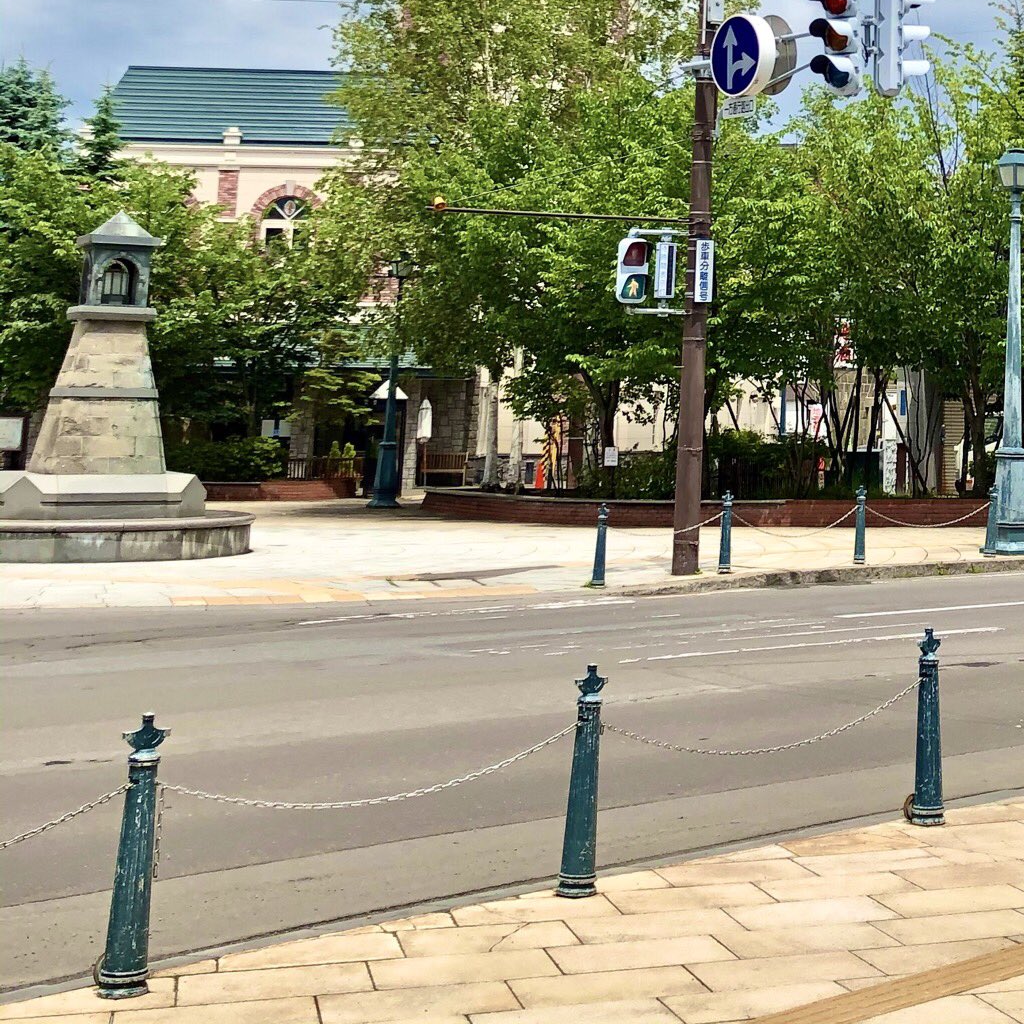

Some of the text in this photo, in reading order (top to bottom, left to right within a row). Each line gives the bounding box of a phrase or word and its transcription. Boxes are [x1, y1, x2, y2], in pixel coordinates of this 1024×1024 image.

[699, 241, 710, 301] 歩車分離信号
